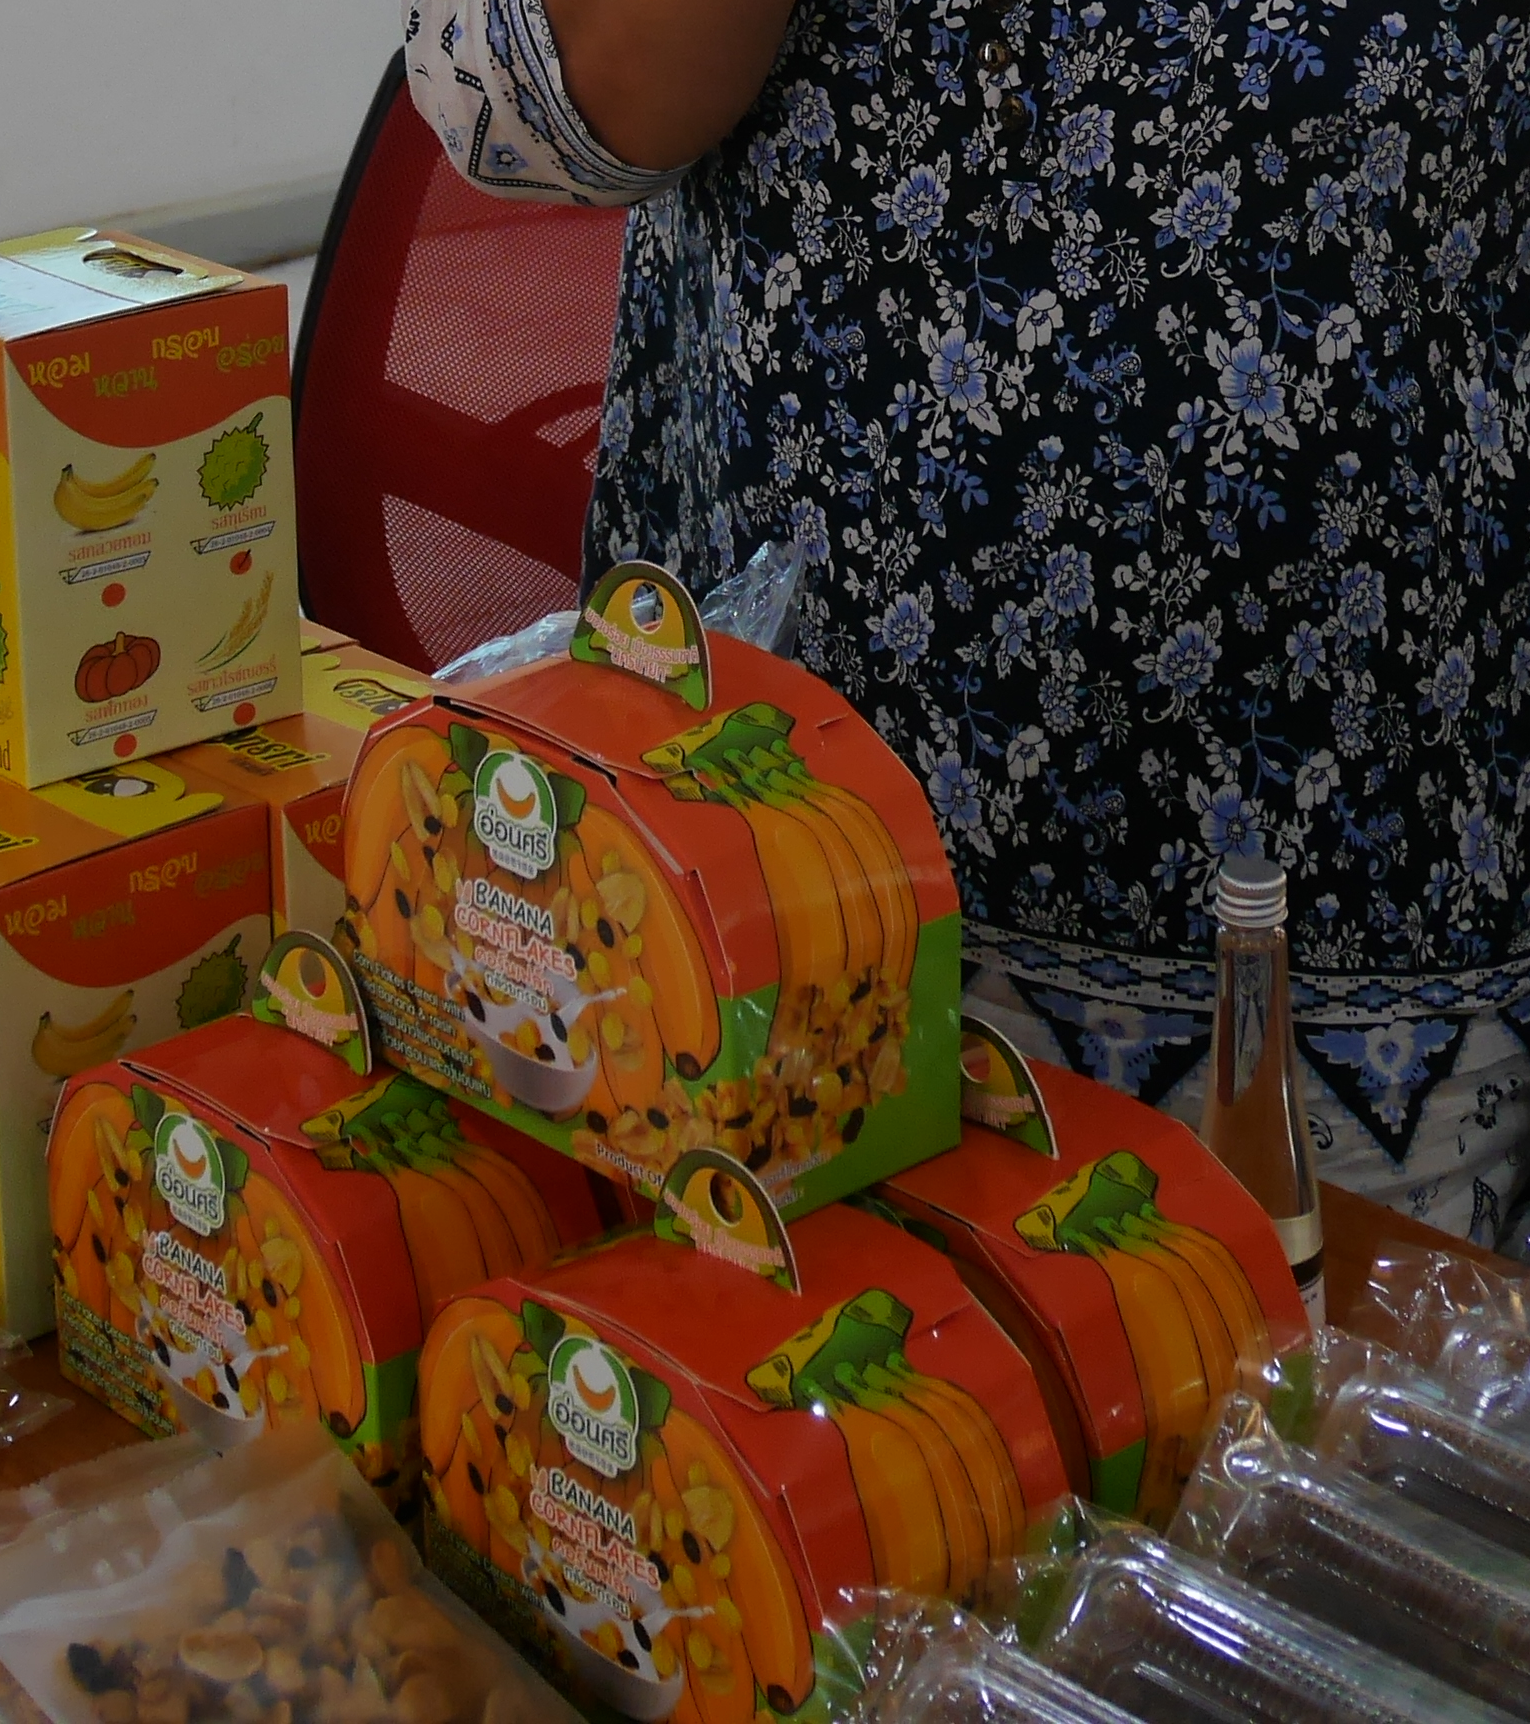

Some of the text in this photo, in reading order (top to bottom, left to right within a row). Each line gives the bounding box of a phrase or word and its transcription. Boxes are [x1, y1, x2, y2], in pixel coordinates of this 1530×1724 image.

[27, 351, 92, 389] หอม
[151, 324, 221, 362] กรอบ
[479, 807, 549, 860] อ่อนศรี
[474, 881, 554, 937] BANANA
[455, 906, 577, 981] CORNFLAKES
[407, 980, 439, 1009] Cereal
[595, 1139, 645, 1180] Product
[161, 1162, 219, 1220] อ่อนศรี
[159, 1233, 227, 1291] BANANA
[143, 1255, 246, 1334] CORNFLAKES
[555, 1398, 629, 1460] อ่อนศรี
[551, 1471, 635, 1541] BANANA
[530, 1493, 661, 1591] CORNFLAKES
